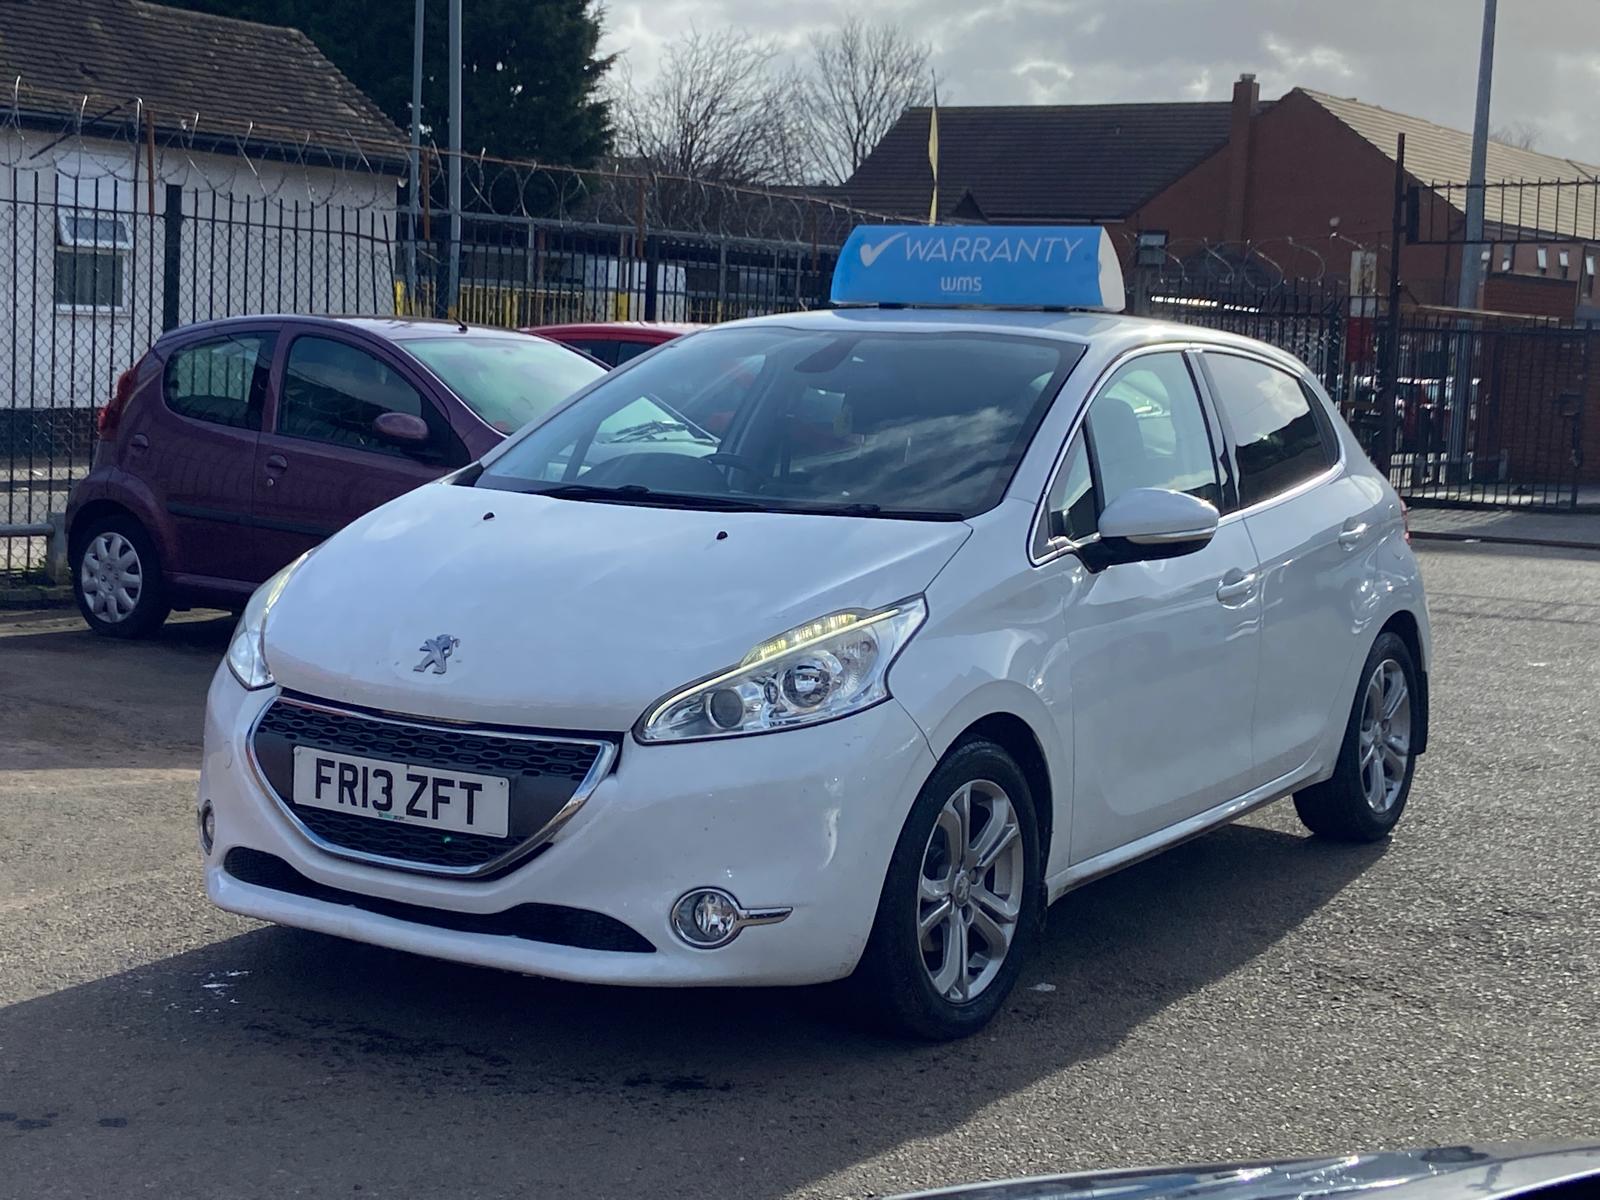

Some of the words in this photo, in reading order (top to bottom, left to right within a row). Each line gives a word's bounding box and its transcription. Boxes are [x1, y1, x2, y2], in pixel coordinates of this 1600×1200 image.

[905, 236, 1084, 263] WARRANTY
[940, 275, 983, 292] wms
[315, 757, 393, 812] FR13
[405, 773, 483, 825] ZFT
